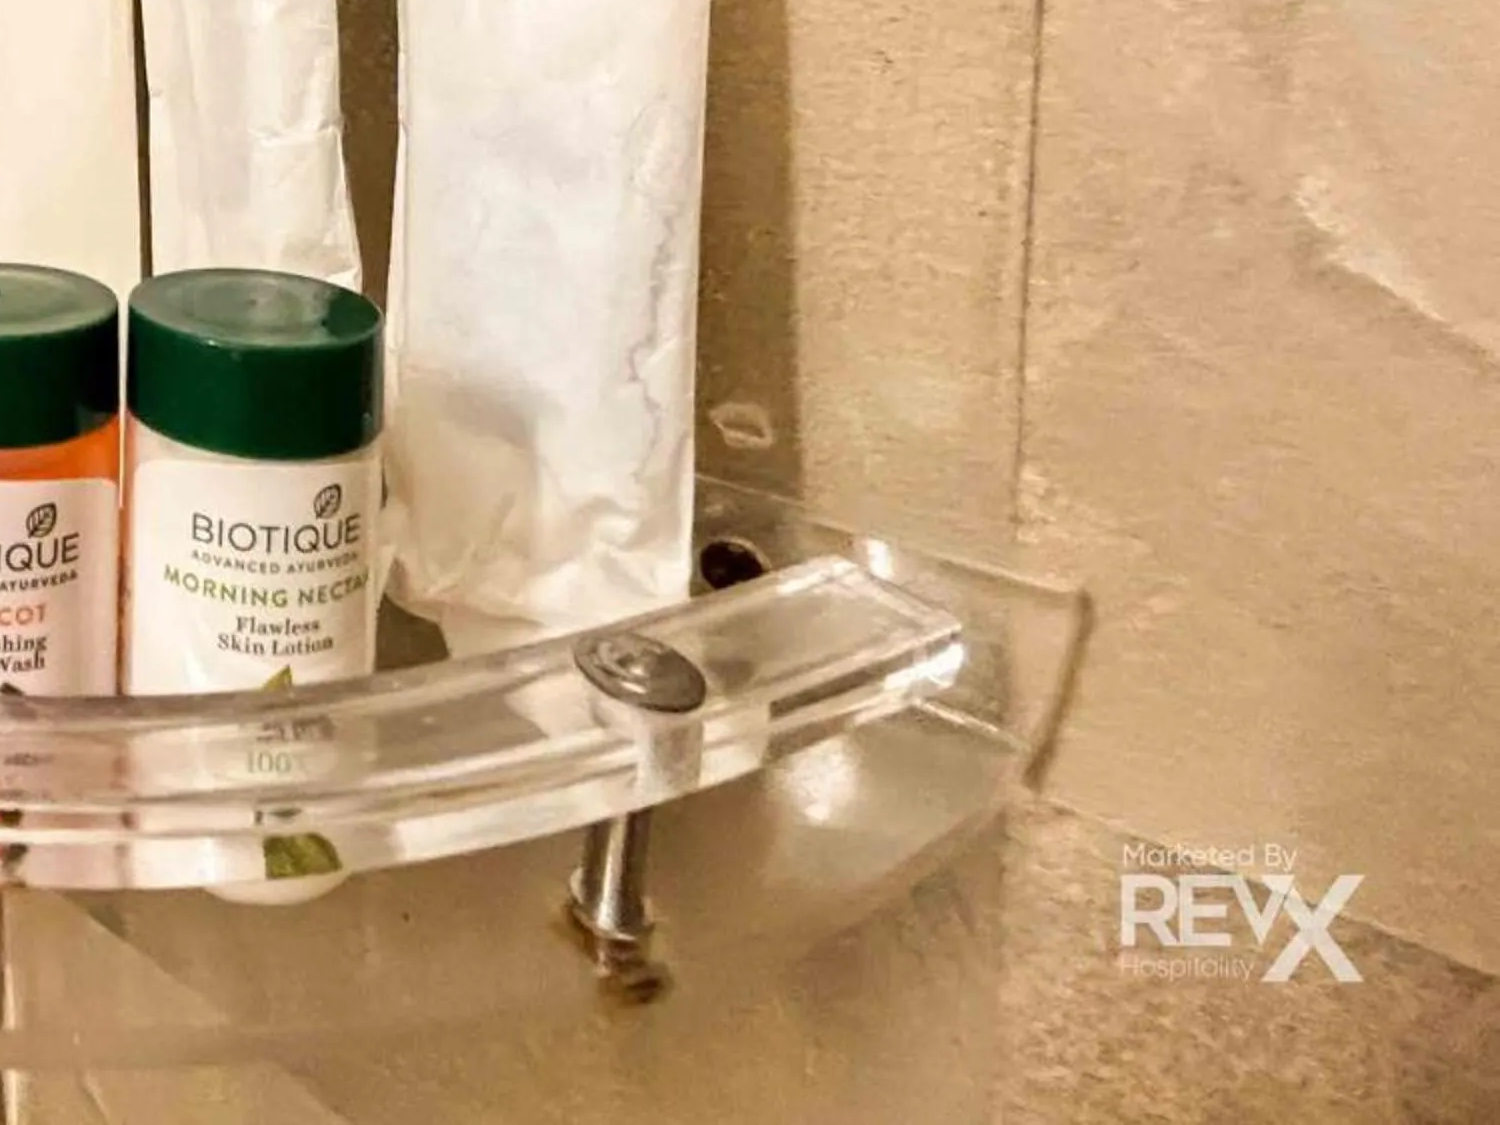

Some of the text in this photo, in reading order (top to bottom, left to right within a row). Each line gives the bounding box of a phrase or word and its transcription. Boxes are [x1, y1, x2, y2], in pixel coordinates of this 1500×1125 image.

[191, 512, 361, 555] BIOTIQUE
[191, 549, 281, 574] ADVANCED
[0, 569, 79, 592] AYURVEDA
[163, 564, 288, 608] MORNING
[236, 615, 321, 637] Flawless
[217, 633, 334, 657] Skin Lotion
